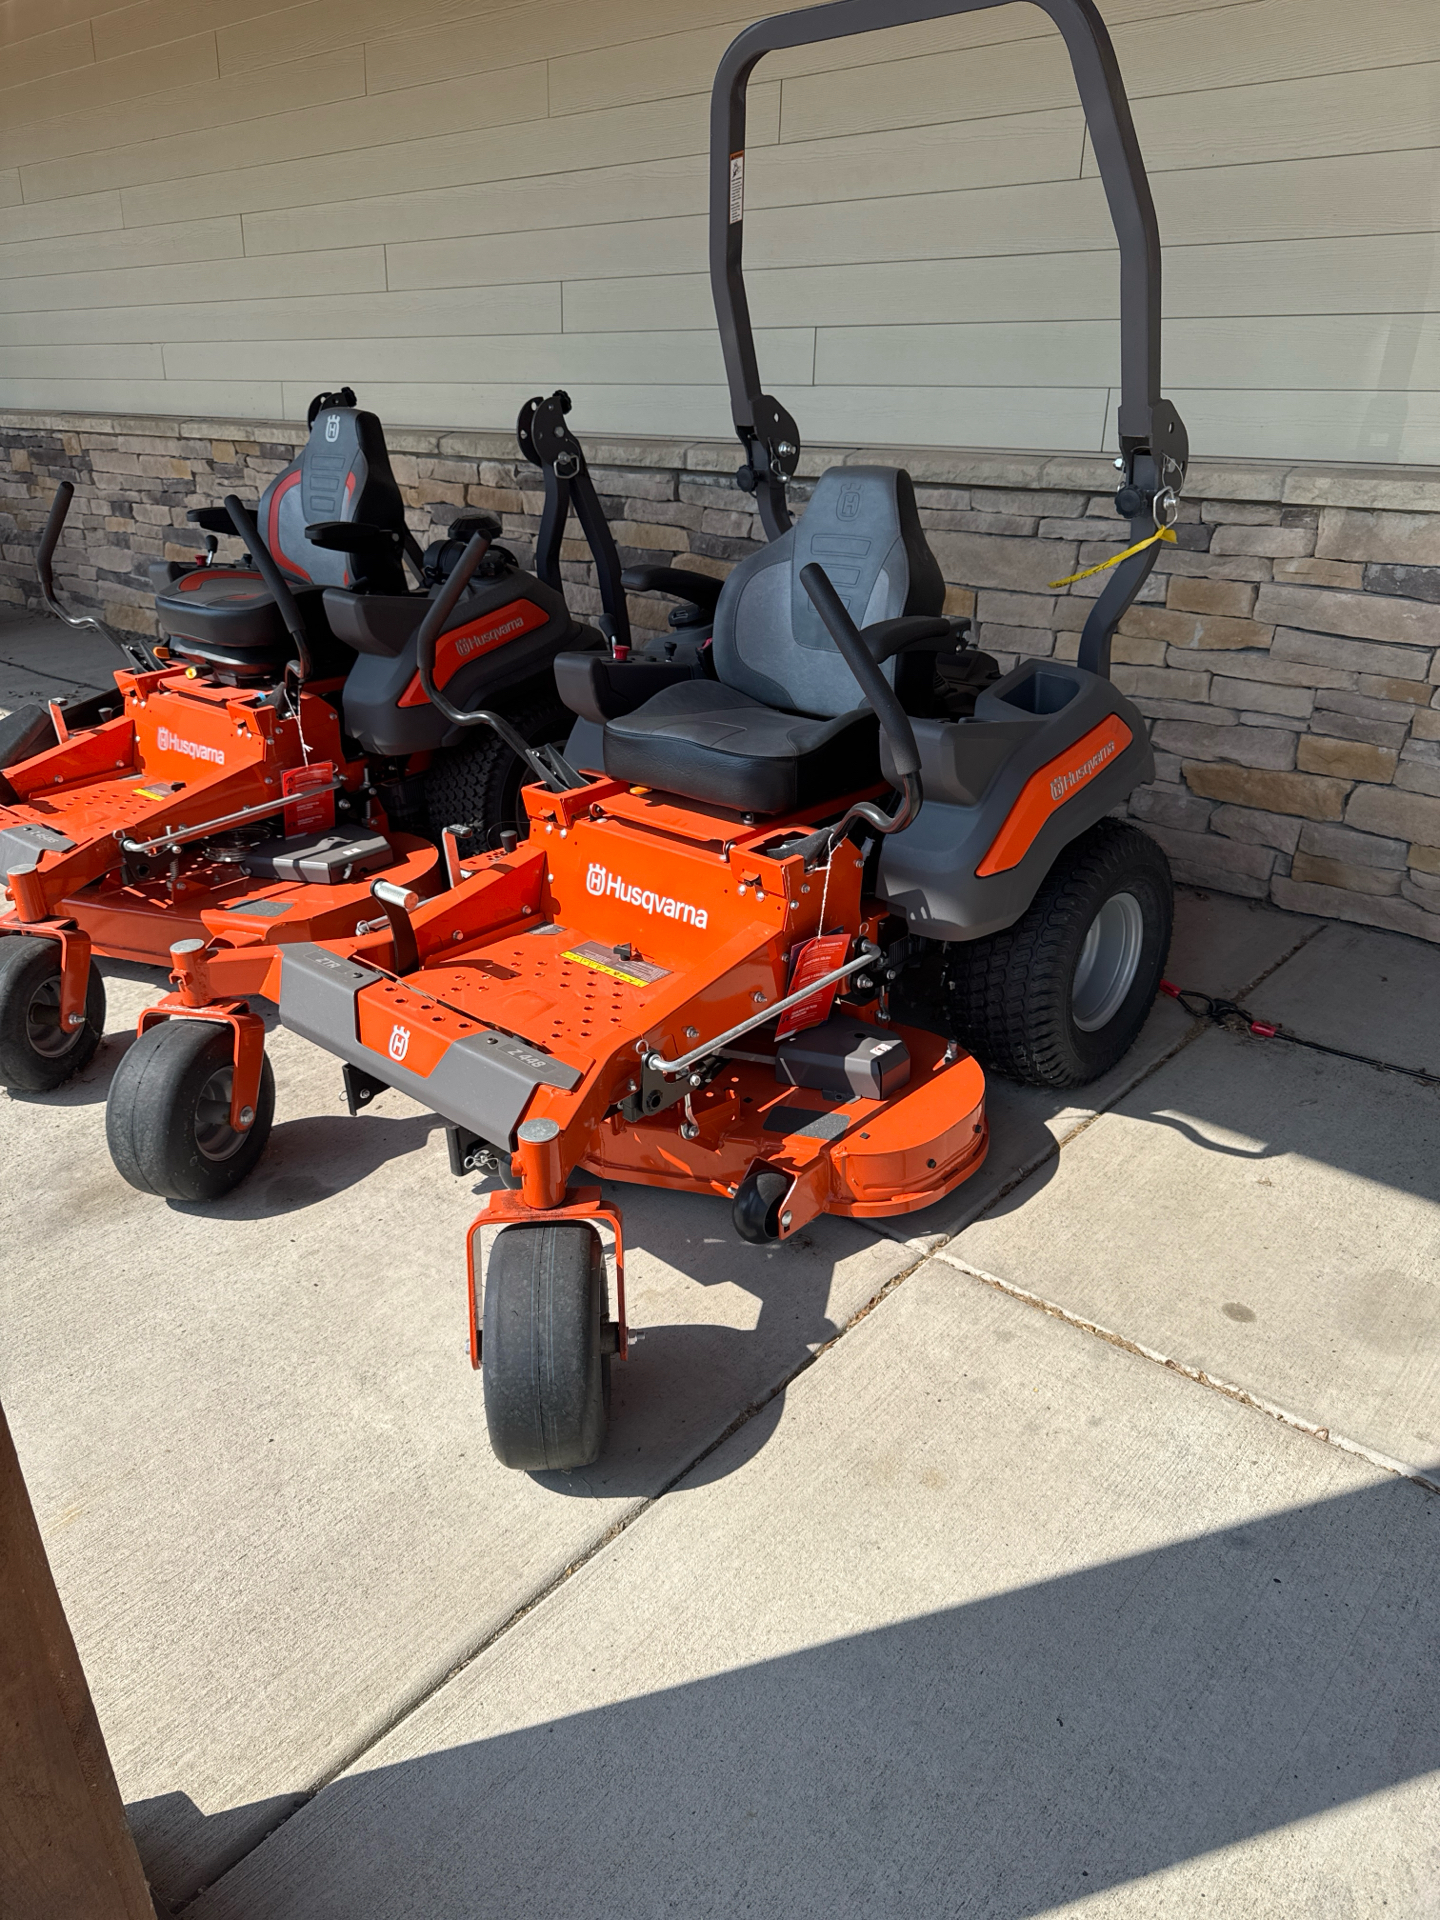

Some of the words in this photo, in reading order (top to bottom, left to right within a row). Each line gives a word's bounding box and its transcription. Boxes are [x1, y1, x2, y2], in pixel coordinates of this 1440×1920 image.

[467, 616, 524, 650] Husqvarna
[168, 731, 225, 766] Husqvarna
[1063, 740, 1116, 791] Husqvarna
[606, 872, 709, 930] Husqvarna
[315, 957, 341, 969] ZTR
[507, 1048, 524, 1056] Z
[518, 1054, 547, 1068] 448
